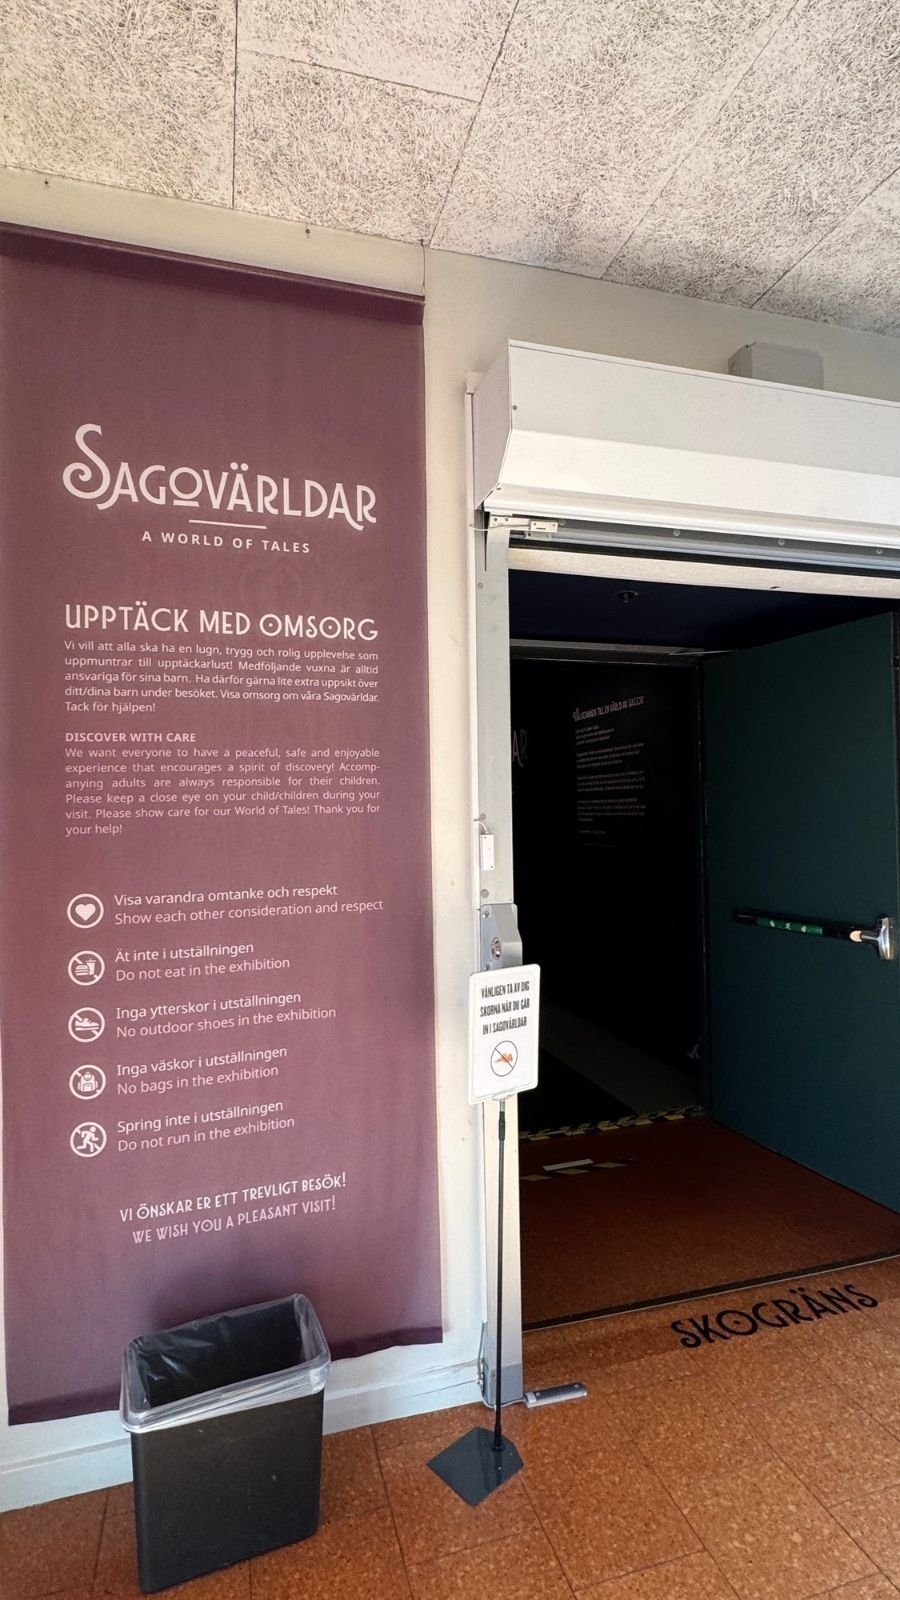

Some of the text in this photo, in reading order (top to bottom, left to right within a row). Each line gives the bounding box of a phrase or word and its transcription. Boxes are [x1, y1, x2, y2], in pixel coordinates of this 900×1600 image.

[62, 423, 377, 531] SAGOVÄRLDAR
[142, 531, 309, 553] A WORLD OF TALES
[66, 601, 378, 640] UPPTÄCK MED OMSORG
[78, 641, 94, 650] vill
[98, 643, 113, 651] att
[117, 642, 136, 651] alla
[140, 642, 158, 652] ska
[196, 644, 222, 656] lugn,
[226, 647, 252, 658] trygg
[257, 648, 274, 656] och
[278, 648, 300, 660] rolig
[304, 649, 355, 660] upplevelse
[65, 658, 133, 668] uppmuntrar
[138, 658, 151, 667] till
[158, 659, 232, 670] upptäckarlust!
[239, 661, 301, 673] Medföljande
[355, 665, 378, 674] alltid
[65, 672, 378, 689] ansvariga sina barn. därför gärna lite extra uppsikt över
[65, 686, 110, 696] ditt/dina
[114, 687, 138, 696] barn
[141, 688, 173, 697] under
[175, 688, 218, 698] besöket.
[220, 689, 240, 699] Visa
[243, 692, 280, 702] omsorg
[301, 691, 321, 700] våra
[65, 702, 155, 714] Tack hjälpen!
[66, 733, 196, 742] DISCOVER WITH CARE
[88, 748, 379, 759] want everyone have peaceful, safe and enjoyable
[65, 762, 380, 775] experience that encourages spirit discovery! Accomp-
[65, 776, 380, 791] anying adults always responsible their children.
[66, 791, 355, 805] Please keep close eye your child/children during
[65, 809, 91, 819] visit.
[96, 809, 131, 818] Please
[135, 808, 164, 817] show
[235, 806, 265, 815] World
[282, 805, 309, 814] Tales!
[313, 804, 343, 813] Thank
[346, 806, 363, 815] you
[66, 824, 122, 837] your help!
[114, 884, 338, 906] Visa varandra omtanke och respekt
[115, 901, 383, 925] Show each other consideration and respect
[115, 944, 253, 962] Ät inte utställningen
[116, 958, 290, 981] Do not eat exhibition
[507, 984, 513, 994] TA
[521, 980, 530, 992] DIG
[116, 994, 301, 1021] Inga ytterskor utställningen
[480, 1003, 501, 1017] SKORNA
[117, 1008, 336, 1037] No outdoor shoes exhibition
[482, 1024, 489, 1035] IN
[117, 1048, 287, 1078] Inga väskor utställningen
[118, 1067, 278, 1095] No bags exhibition
[117, 1102, 283, 1135] Spring inte utställningen
[118, 1118, 294, 1151] Do not run exhibition
[120, 1172, 346, 1222] VI ÖNSKAR ER ETT TREVLIGT BESÖK!
[132, 1195, 335, 1243] WE WISH YOU A PLEASANT VISIT!
[671, 1284, 879, 1348] SKOGRÄNS
